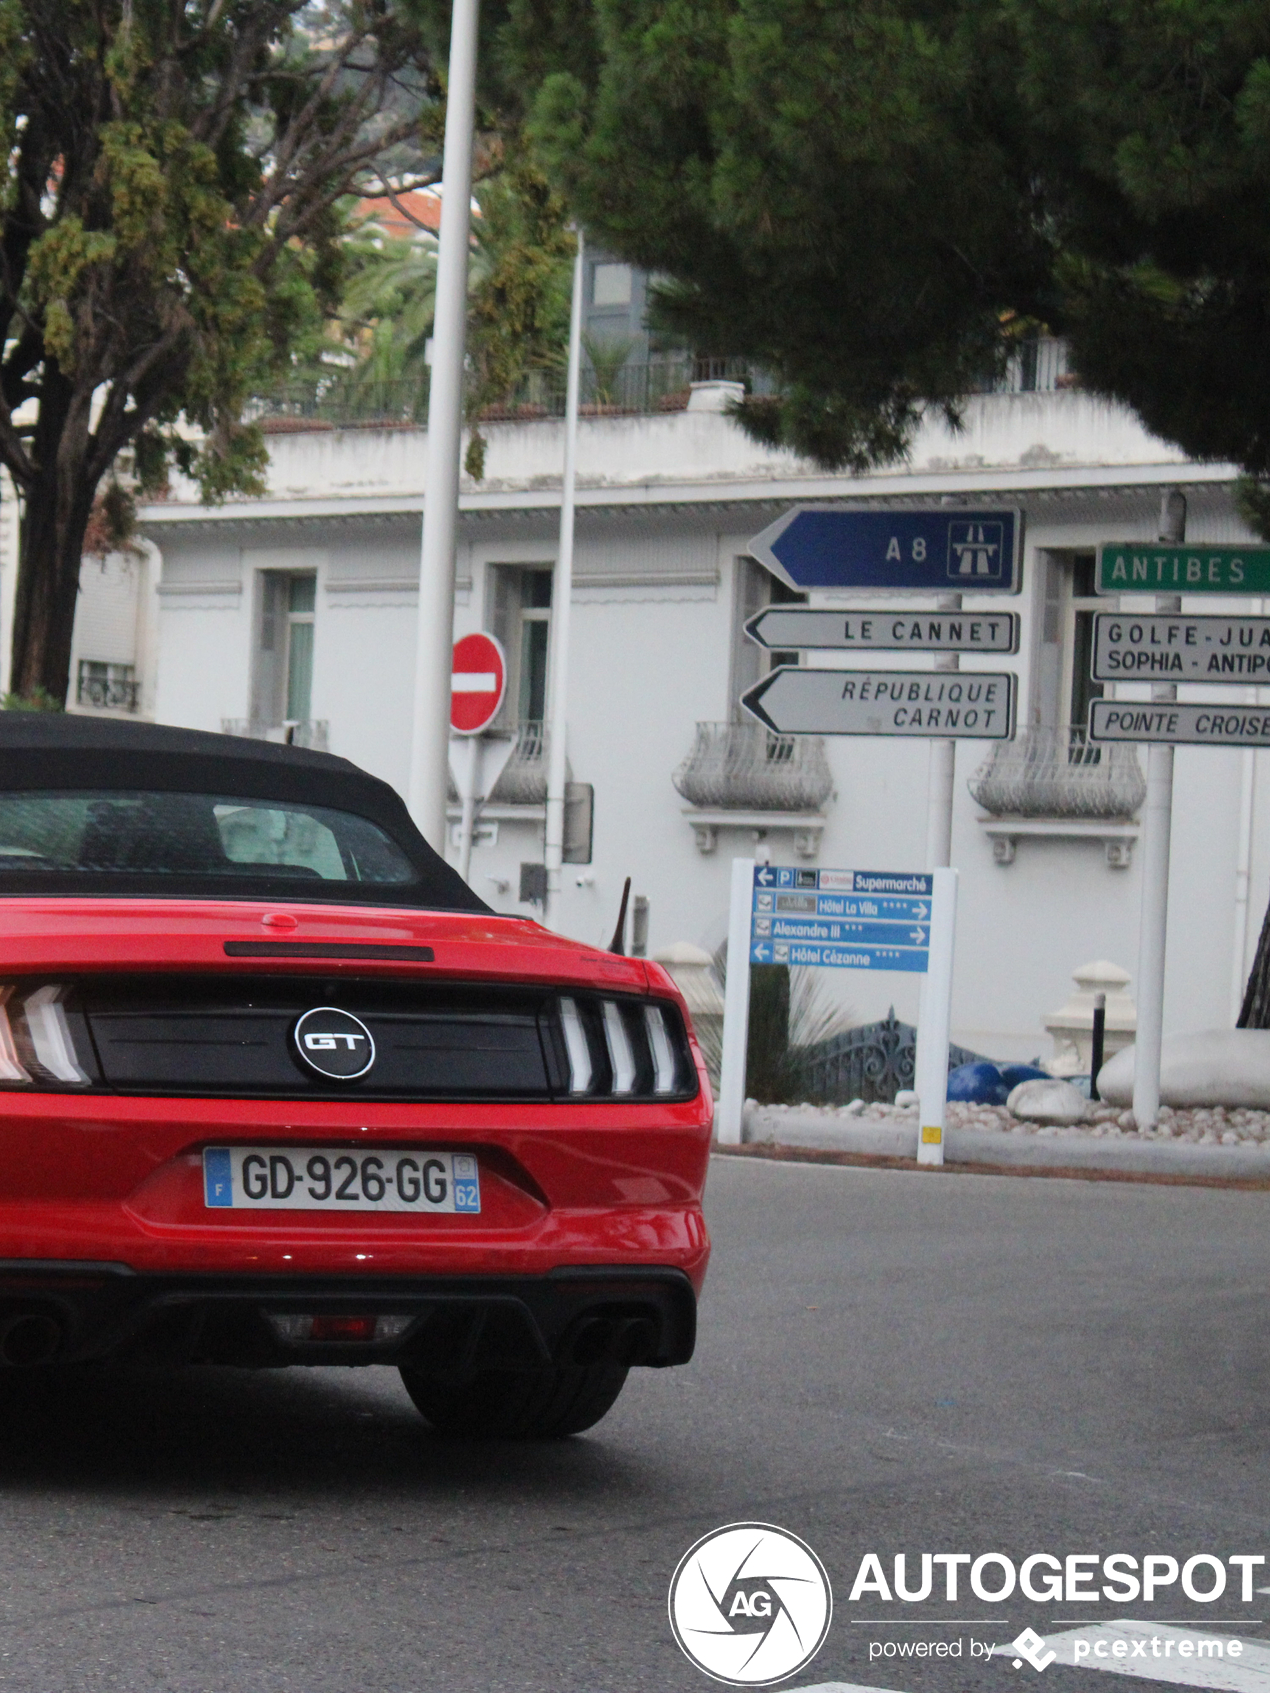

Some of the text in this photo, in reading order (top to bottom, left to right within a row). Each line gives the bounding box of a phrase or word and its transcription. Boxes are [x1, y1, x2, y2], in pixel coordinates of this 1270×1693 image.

[1112, 556, 1245, 583] ANTIBES
[844, 620, 1000, 642] LE CANNET
[1108, 650, 1183, 671] SOPHIA
[1207, 652, 1270, 673] ANTIP
[841, 677, 998, 704] RÉPUBLIQUE
[893, 707, 996, 729] CARNOT
[1105, 711, 1179, 732] POINTE
[856, 874, 927, 893] Supermarché
[819, 898, 844, 914] Hôtel
[846, 900, 857, 914] La
[859, 901, 878, 915] Villa
[773, 921, 840, 938] Alexandre III
[791, 947, 870, 966] Hôtel Cézanne
[304, 1033, 365, 1050] GT
[215, 1154, 478, 1206] F GD-926-GG 62
